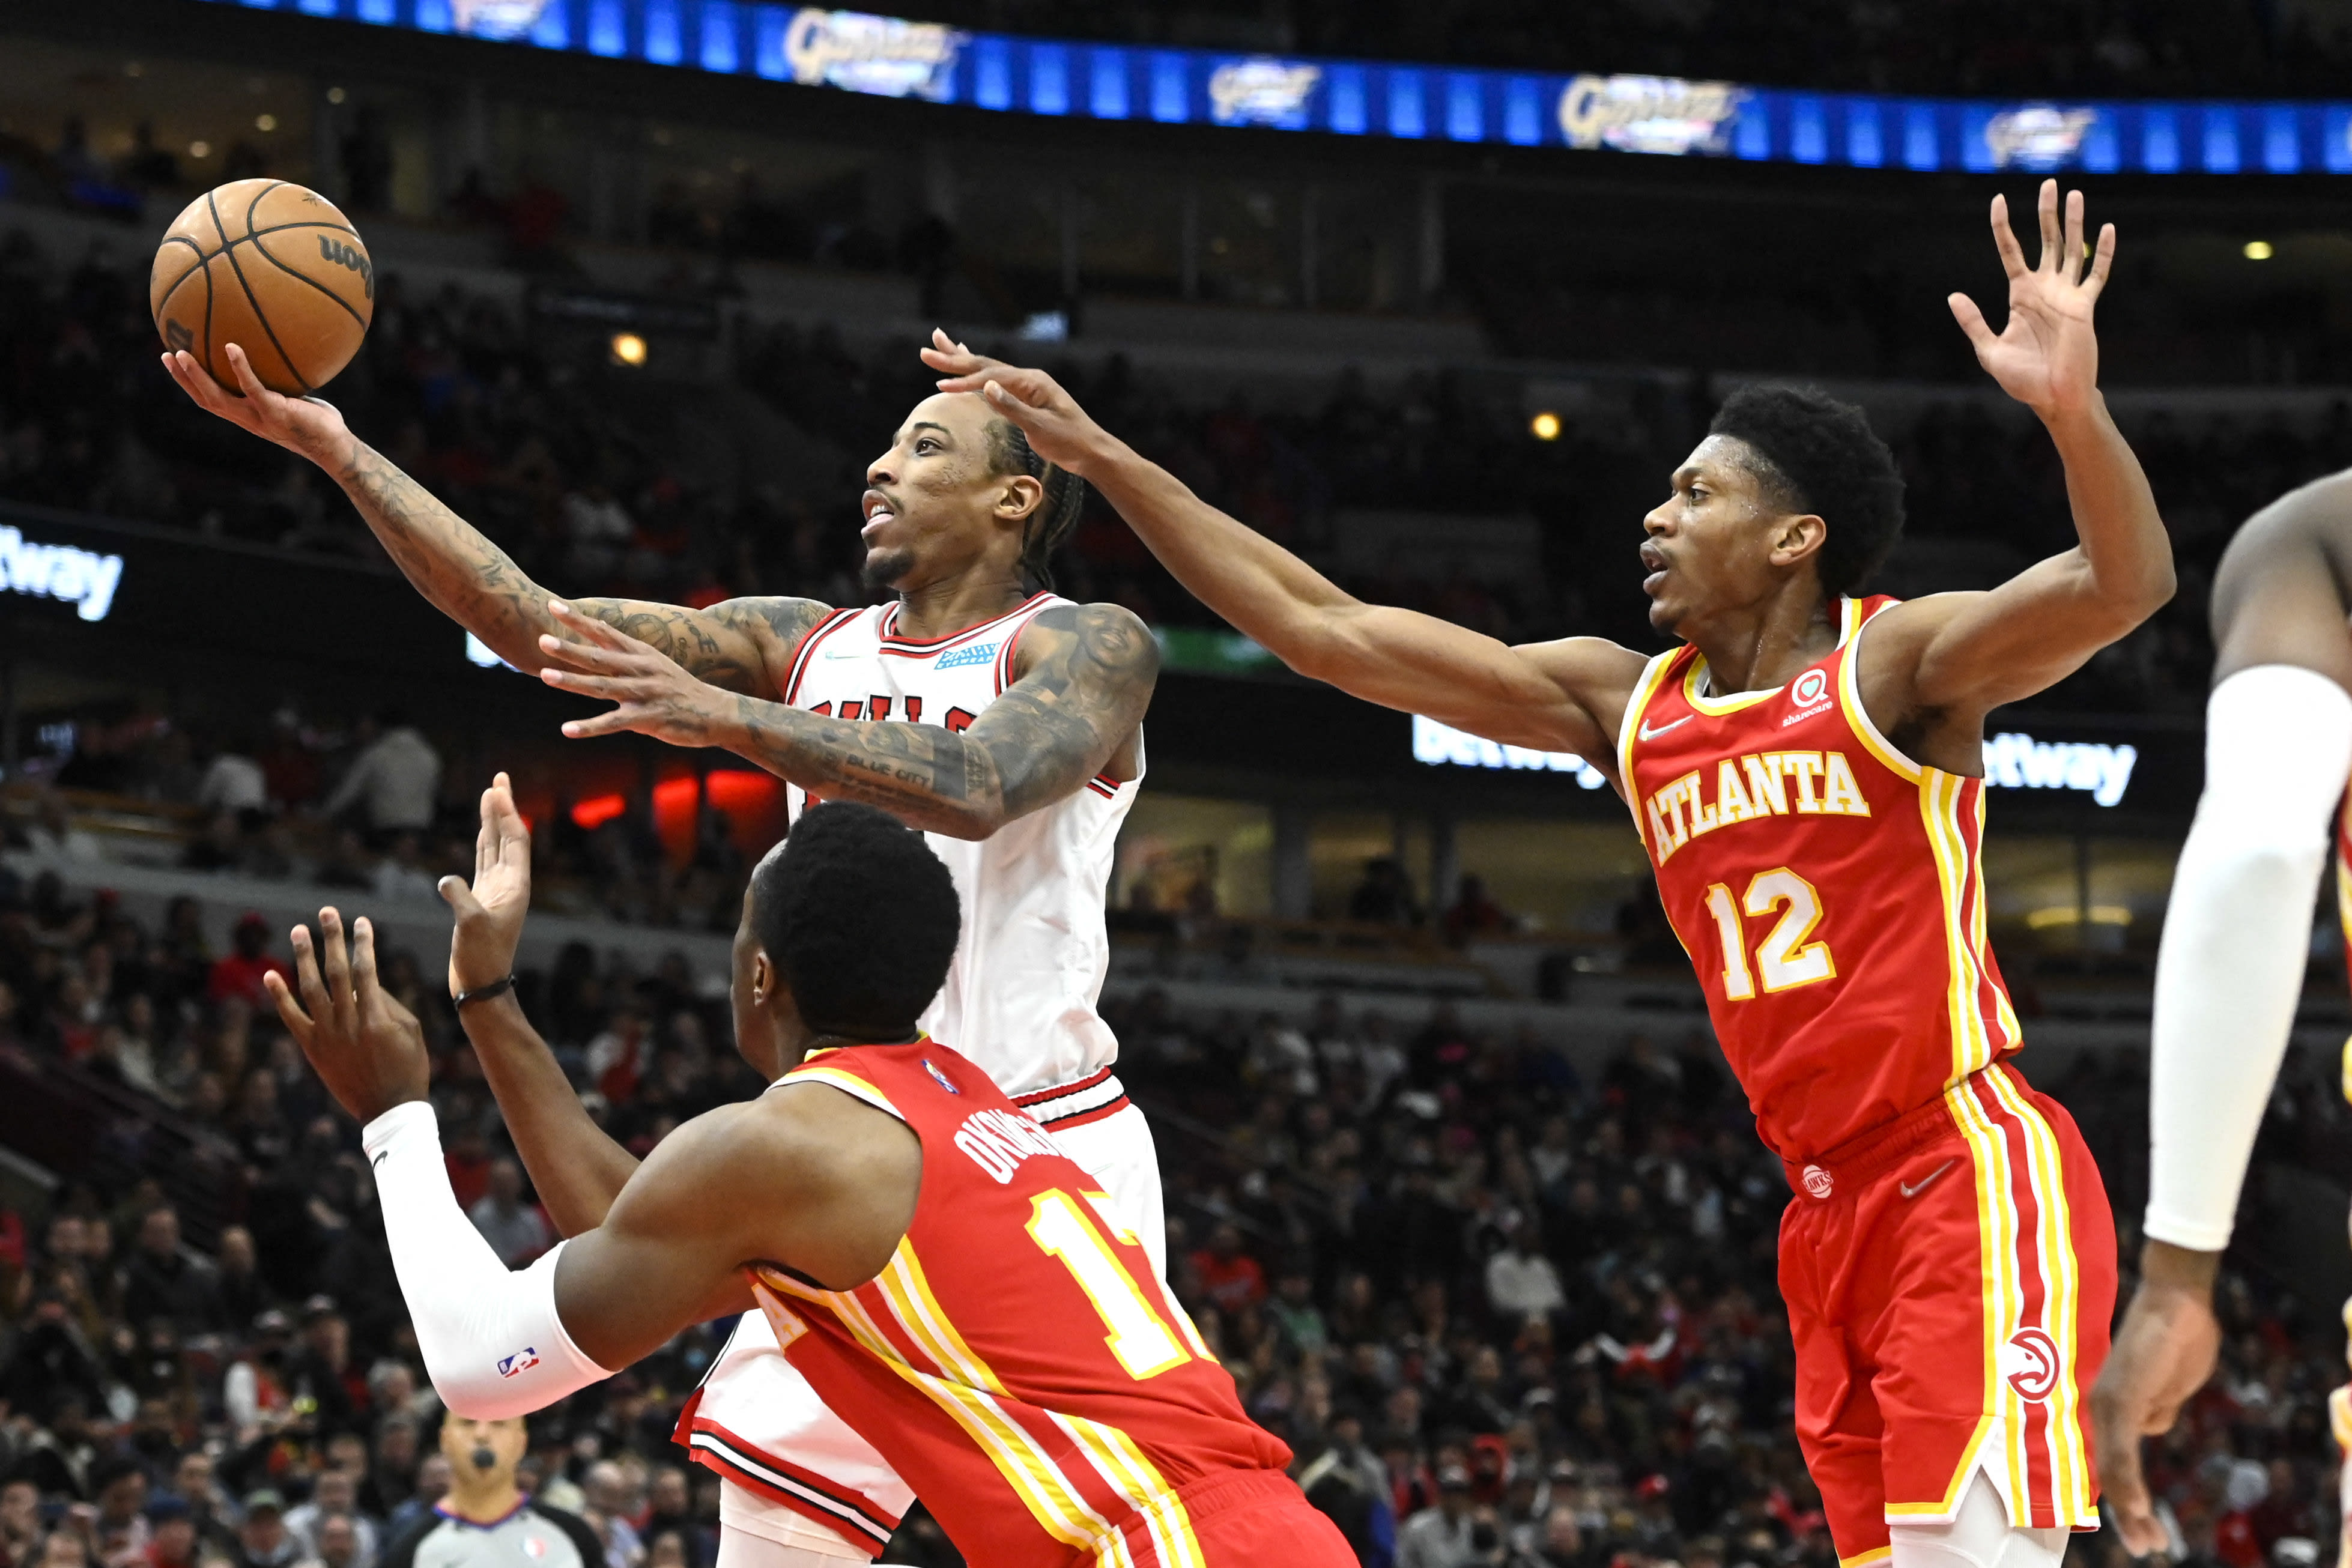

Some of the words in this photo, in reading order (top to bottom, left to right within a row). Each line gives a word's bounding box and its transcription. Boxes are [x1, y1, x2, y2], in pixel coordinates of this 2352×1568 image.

[1782, 701, 1833, 727] sharecare
[1646, 750, 1871, 868] ATLANTA
[1705, 867, 1837, 1001] 12
